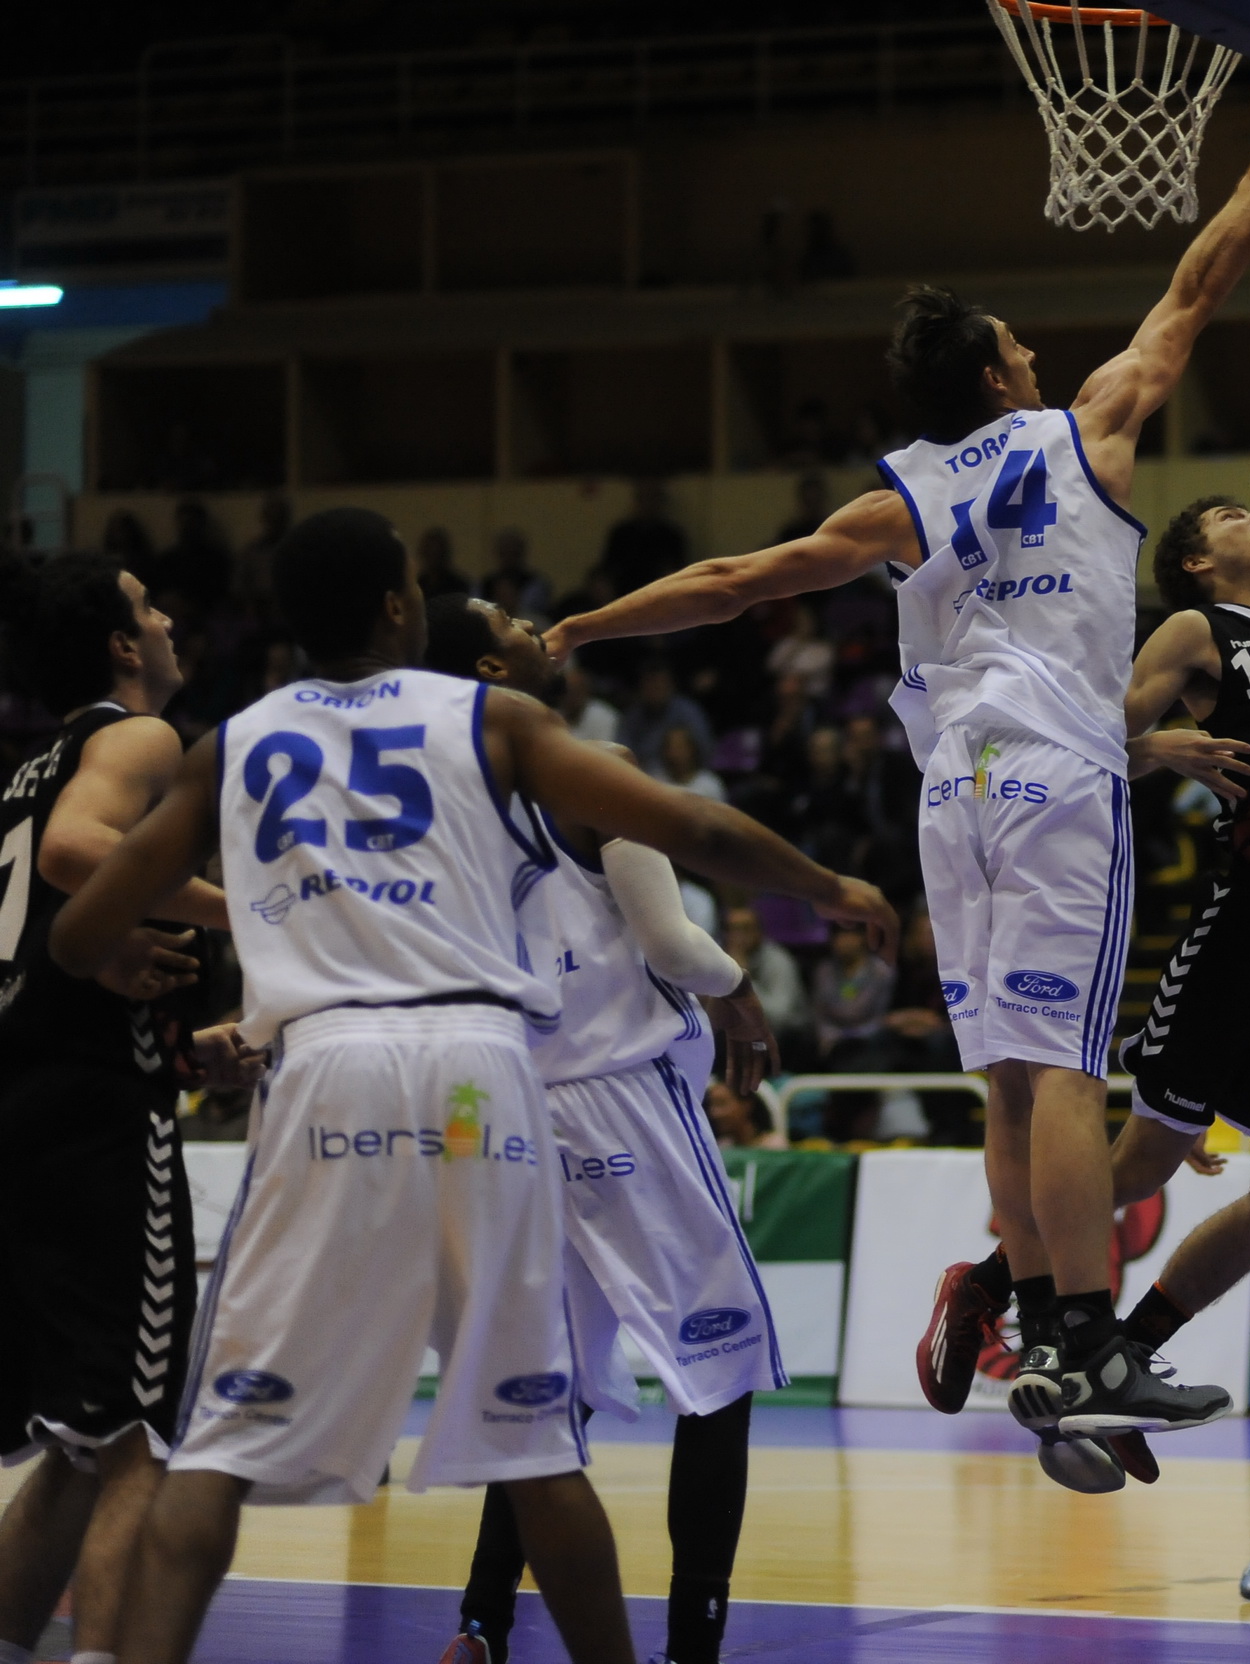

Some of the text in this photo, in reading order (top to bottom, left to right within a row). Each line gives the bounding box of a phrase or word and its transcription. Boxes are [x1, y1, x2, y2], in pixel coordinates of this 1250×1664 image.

[1022, 534, 1044, 545] CBT
[961, 550, 984, 568] CBT
[244, 724, 434, 864] 25
[1017, 973, 1064, 998] Ford
[995, 996, 1081, 1023] Tarraco Center
[1163, 1088, 1206, 1113] hummel
[690, 1314, 735, 1340] Ford
[676, 1333, 763, 1367] Tarraco Center
